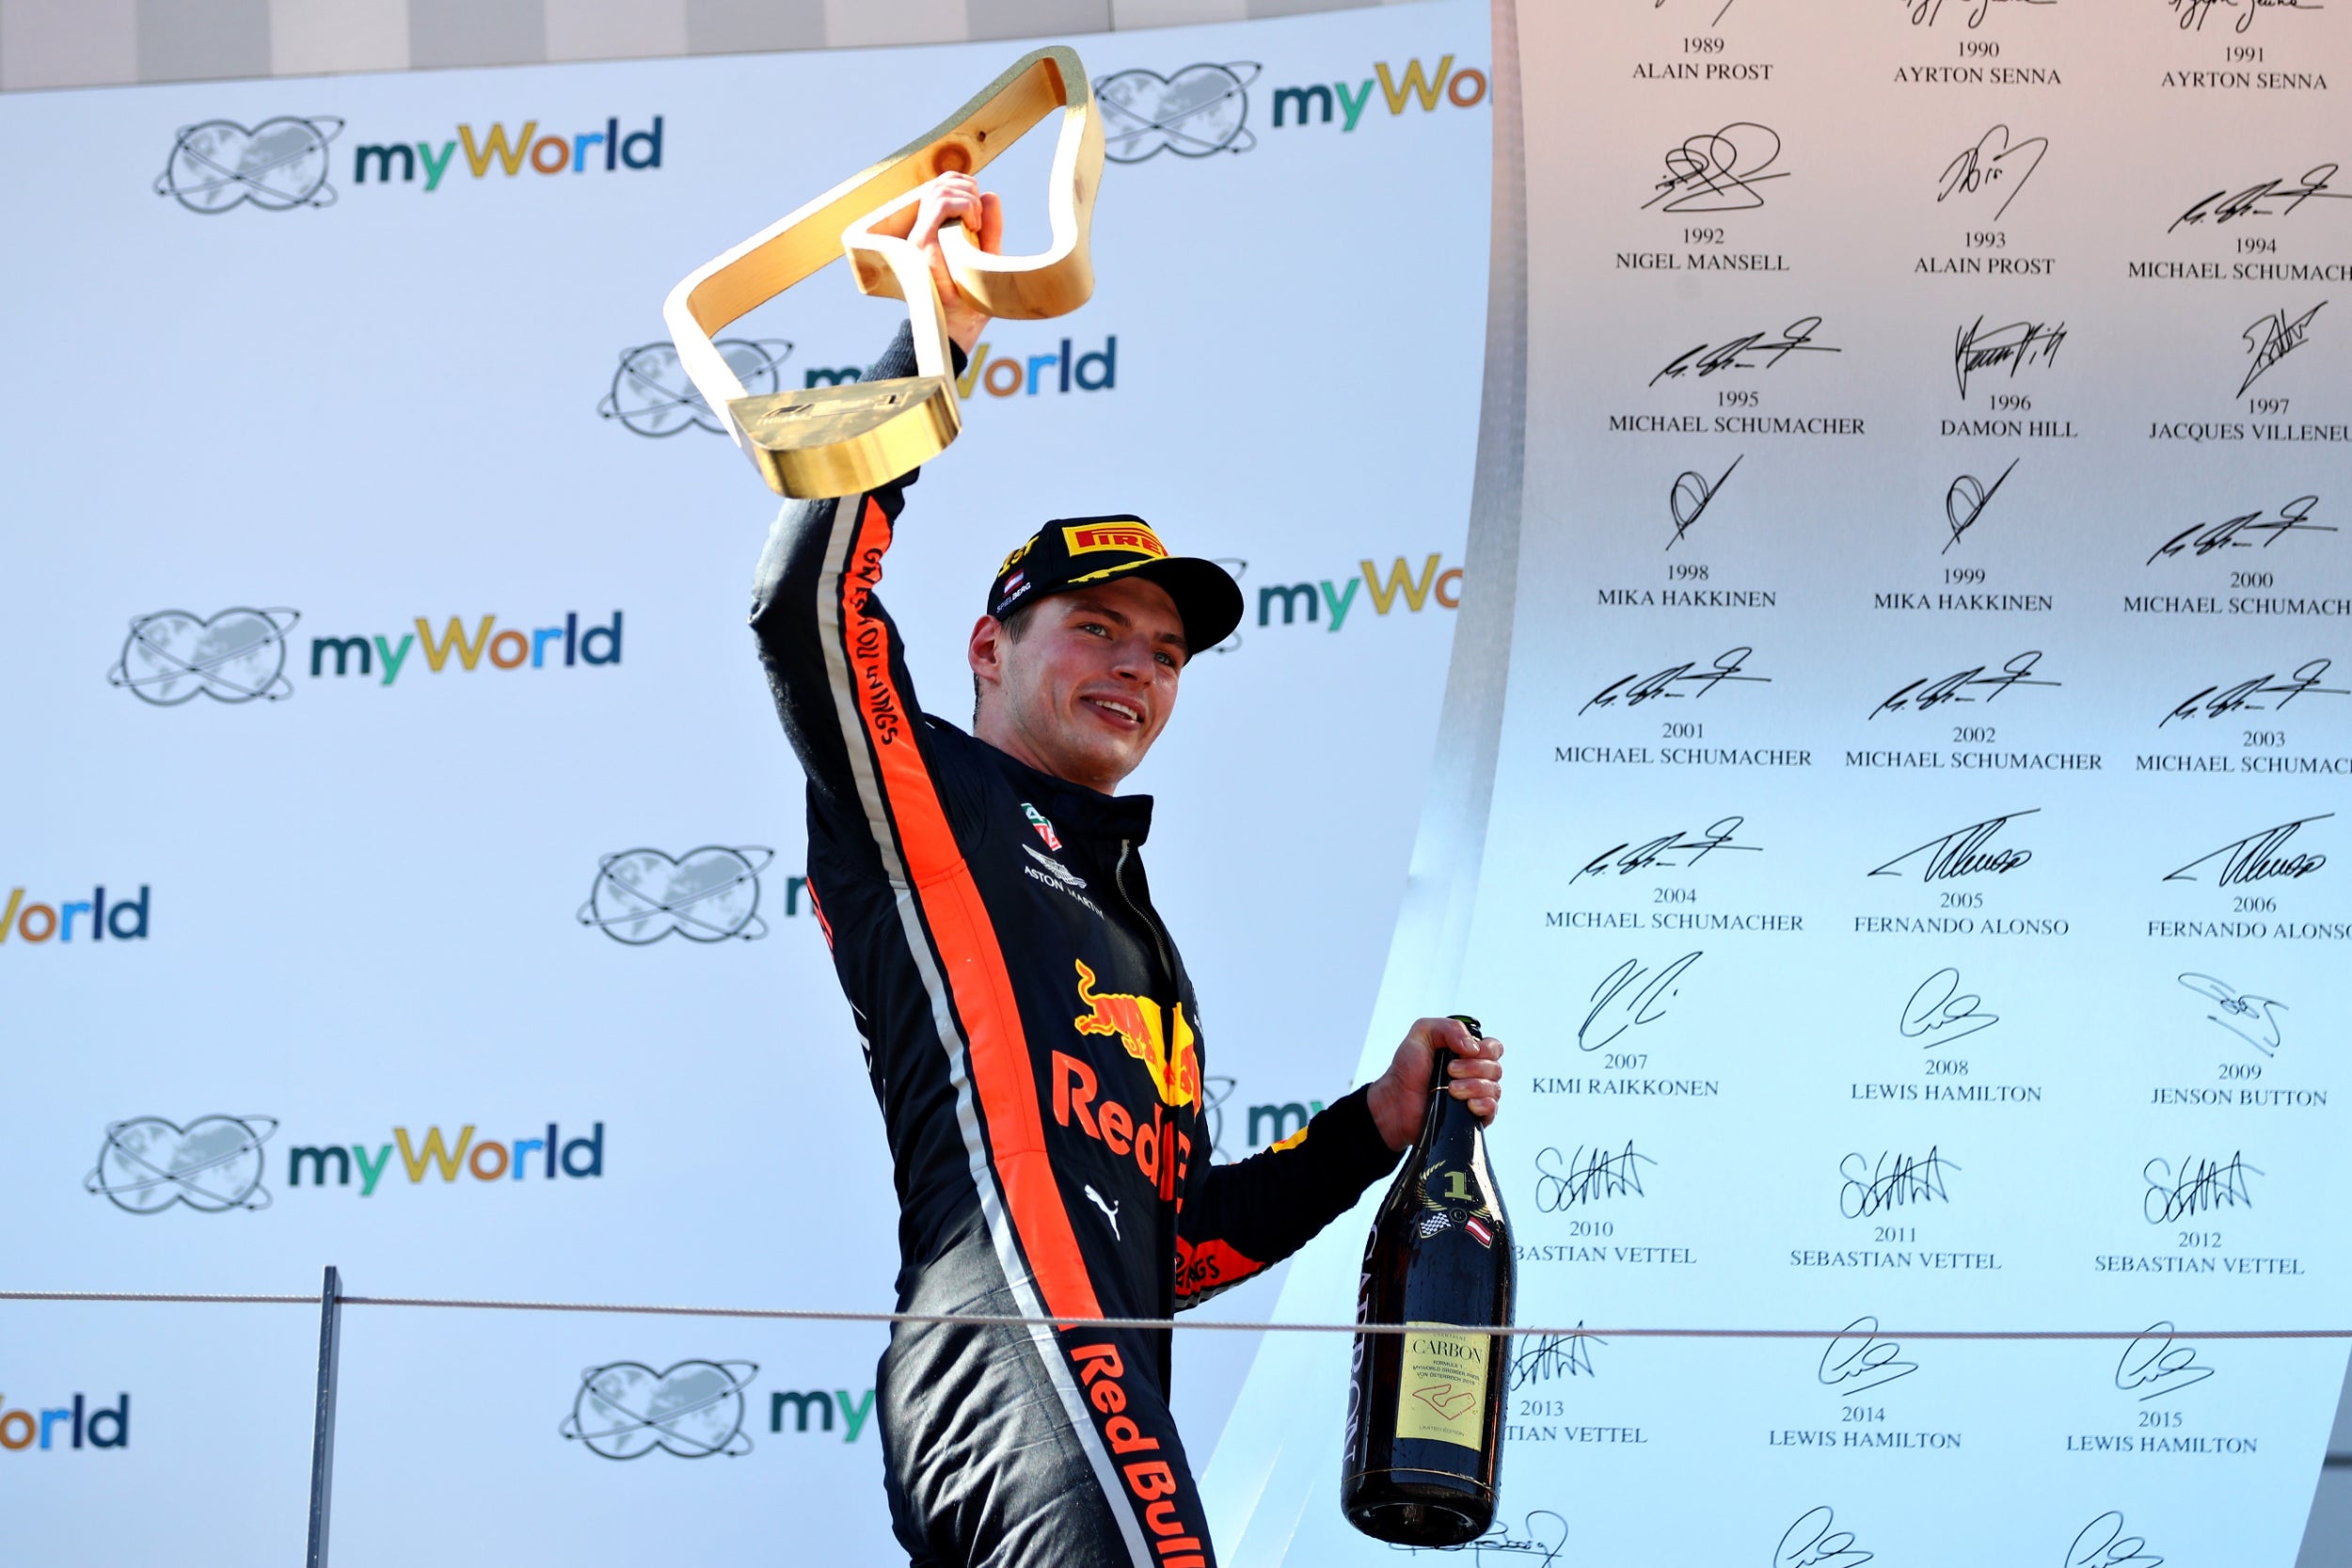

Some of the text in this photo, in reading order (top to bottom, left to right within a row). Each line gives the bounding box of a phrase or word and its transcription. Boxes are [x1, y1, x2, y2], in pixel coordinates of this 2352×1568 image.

[1684, 37, 1725, 54] 1989
[1959, 40, 2000, 57] 1990
[2226, 46, 2264, 63] 1991
[1632, 62, 1773, 81] ALAIN PROST
[1894, 66, 2061, 86] AYRTON SENNA
[2161, 71, 2328, 90] AYRTON SENNA
[1272, 55, 1492, 132] myWo
[354, 115, 664, 192] myWorld
[1684, 228, 1724, 245] 1992
[1966, 231, 2007, 248] 1993
[2237, 237, 2277, 255] 1994
[1616, 252, 1789, 271] NIGEL MANSELL
[1914, 257, 2055, 275] ALAIN PROST
[2128, 261, 2227, 279] MICHAEL
[1719, 390, 1759, 408] 1995
[1991, 394, 2032, 411] 1996
[2249, 398, 2290, 415] 1997
[1609, 415, 1865, 435] MICHAEL SCHUMACHER
[1941, 419, 2077, 438] DAMON HILL
[2149, 421, 2245, 443] JACQUES
[1668, 563, 1709, 581] 1998
[1945, 568, 1986, 585] 1999
[2230, 571, 2274, 589] 2000
[996, 581, 1032, 613] SPIELBERG
[1597, 589, 1776, 608] MIKA HAKKINEN
[1874, 593, 2053, 611] MIKA HAKKINEN
[2123, 595, 2223, 614] MICHAEL
[310, 610, 624, 686] myWorld
[1662, 721, 1703, 739] 2001
[1952, 726, 1996, 744] 2002
[2243, 730, 2286, 748] 2003
[1554, 746, 1812, 767] MICHAEL SCHUMACHER
[1845, 751, 2103, 770] MICHAEL SCHUMACHER
[2136, 754, 2352, 775] MICHAEL SCHUMAC
[1025, 865, 1064, 892] ASTON
[1653, 887, 1697, 904] 2004
[1940, 892, 1983, 909] 2005
[2233, 895, 2277, 913] 2006
[1546, 911, 1804, 931] MICHAEL SCHUMACHER
[1854, 916, 2070, 936] FERNANDO ALONSO
[2148, 920, 2267, 939] FERNANDO
[1604, 1053, 1648, 1069] 2007
[1925, 1059, 1969, 1076] 2008
[2218, 1063, 2263, 1080] 2009
[1532, 1077, 1719, 1097] KIMI RAIKKONEN
[1851, 1083, 2042, 1102] LEWIS HAMILTON
[2151, 1087, 2328, 1107] JENSON BUTTON
[1052, 1050, 1164, 1188] Red
[288, 1121, 604, 1196] myWorld
[1444, 1171, 1472, 1201] 1
[1569, 1220, 1614, 1238] 2010
[1874, 1226, 1915, 1243] 2011
[2178, 1230, 2222, 1249] 2012
[1613, 1246, 1697, 1264] VETTEL
[1790, 1249, 2003, 1270] SEBASTIAN VETTEL
[2094, 1255, 2306, 1275] SEBASTIAN VETTEL
[1412, 1339, 1483, 1364] CARBON
[1519, 1399, 1565, 1418] 2013
[1841, 1405, 1886, 1423] 2014
[0, 1392, 130, 1451] orld
[2137, 1410, 2183, 1429] 2015
[1564, 1426, 1648, 1444] VETTEL
[1769, 1430, 1962, 1449] LEWIS HAMILTON
[2066, 1434, 2257, 1454] LEWIS HAMILTON
[1070, 1343, 1206, 1568] Red Bull
